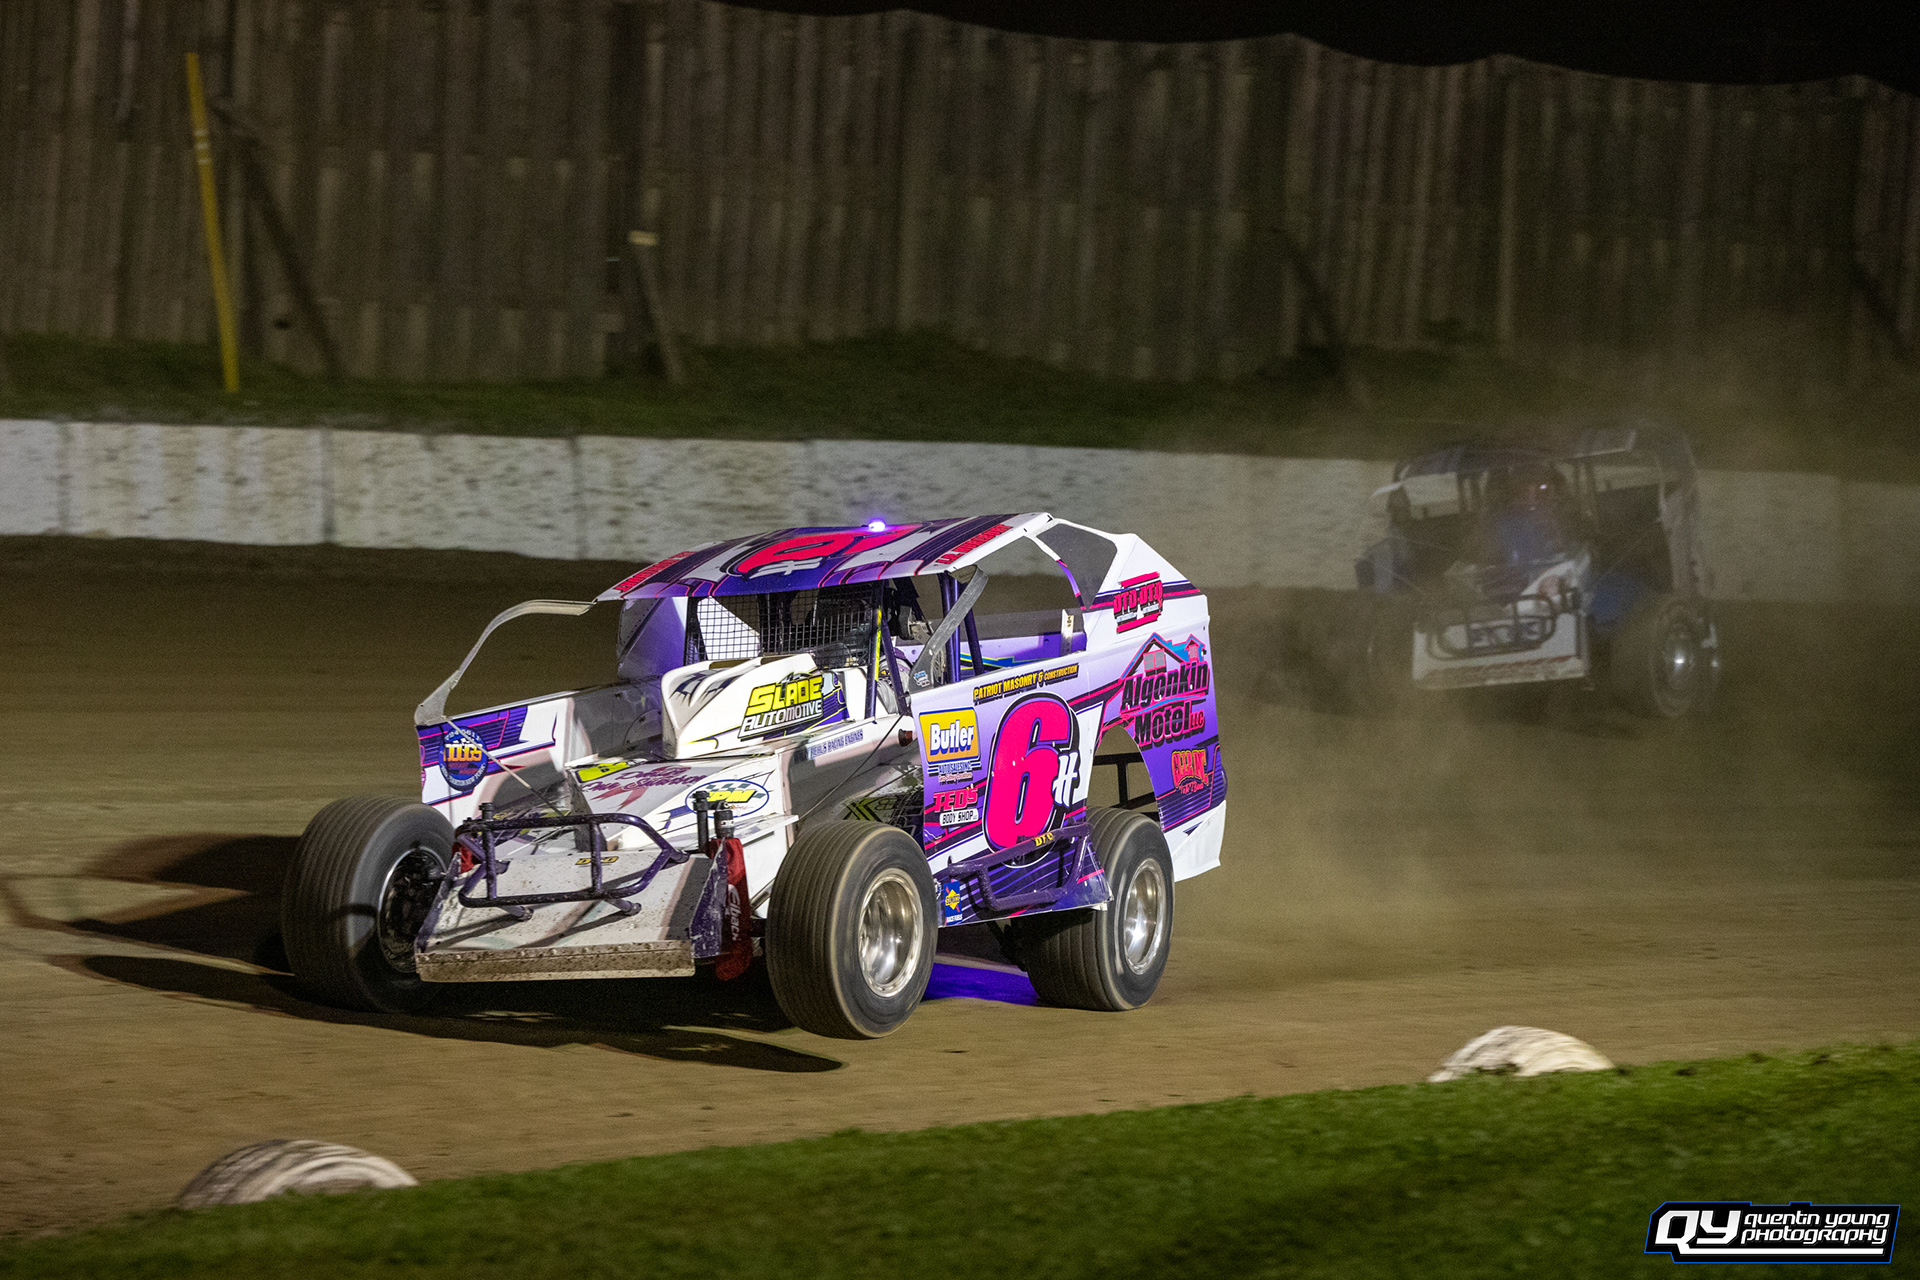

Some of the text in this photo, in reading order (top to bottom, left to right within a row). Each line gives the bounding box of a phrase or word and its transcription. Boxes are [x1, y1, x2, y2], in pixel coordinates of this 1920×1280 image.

[746, 676, 823, 716] SLADE
[973, 665, 1079, 701] PATRIOT MASONRY & CONSTRUCTION
[1120, 661, 1208, 711] Algonkin
[741, 699, 822, 736] AUTOMOTIVE
[1134, 701, 1205, 745] Motel LLC
[930, 720, 974, 755] Butler
[942, 813, 956, 824] BODY
[957, 810, 974, 822] SHOP
